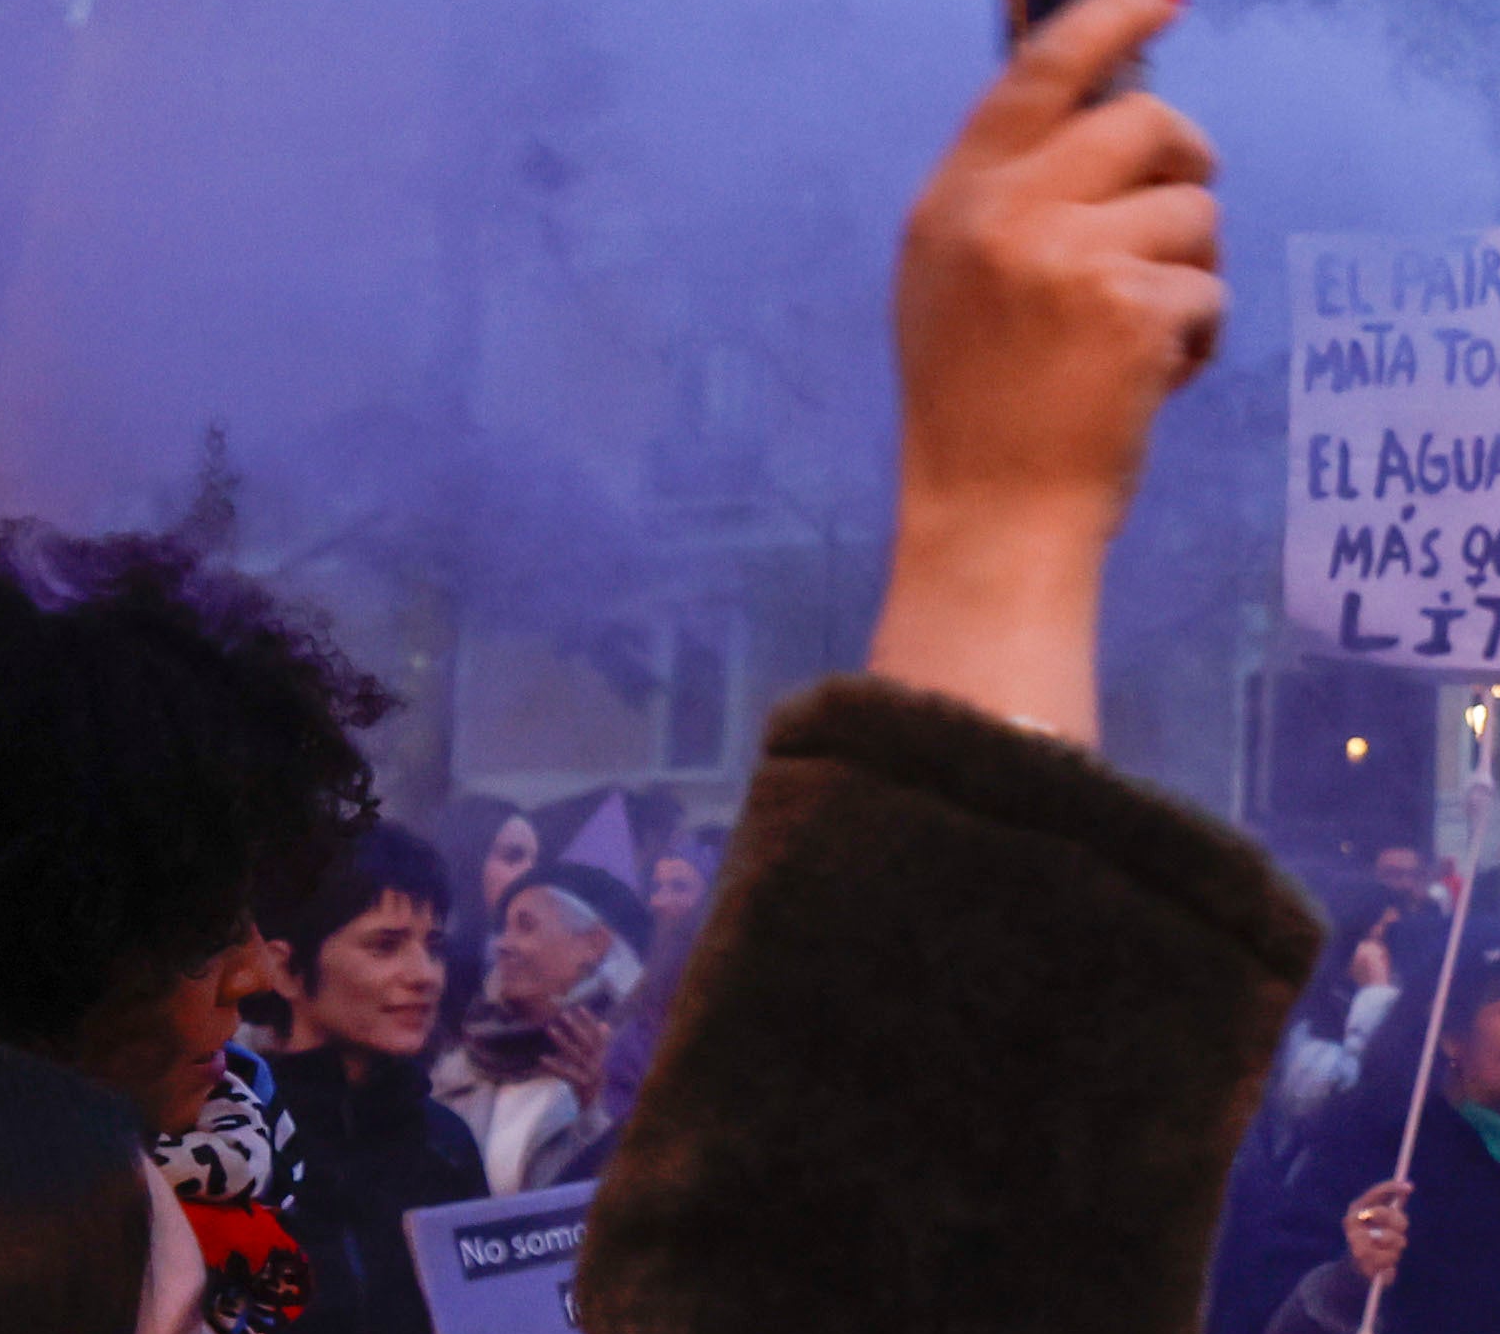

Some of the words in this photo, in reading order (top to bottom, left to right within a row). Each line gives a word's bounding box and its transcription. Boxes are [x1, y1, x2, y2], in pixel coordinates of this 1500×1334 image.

[1314, 253, 1374, 317] EL
[1303, 323, 1418, 393] MATA
[1307, 433, 1360, 501] EL
[1329, 504, 1442, 580] MÁS
[459, 1239, 508, 1269] No
